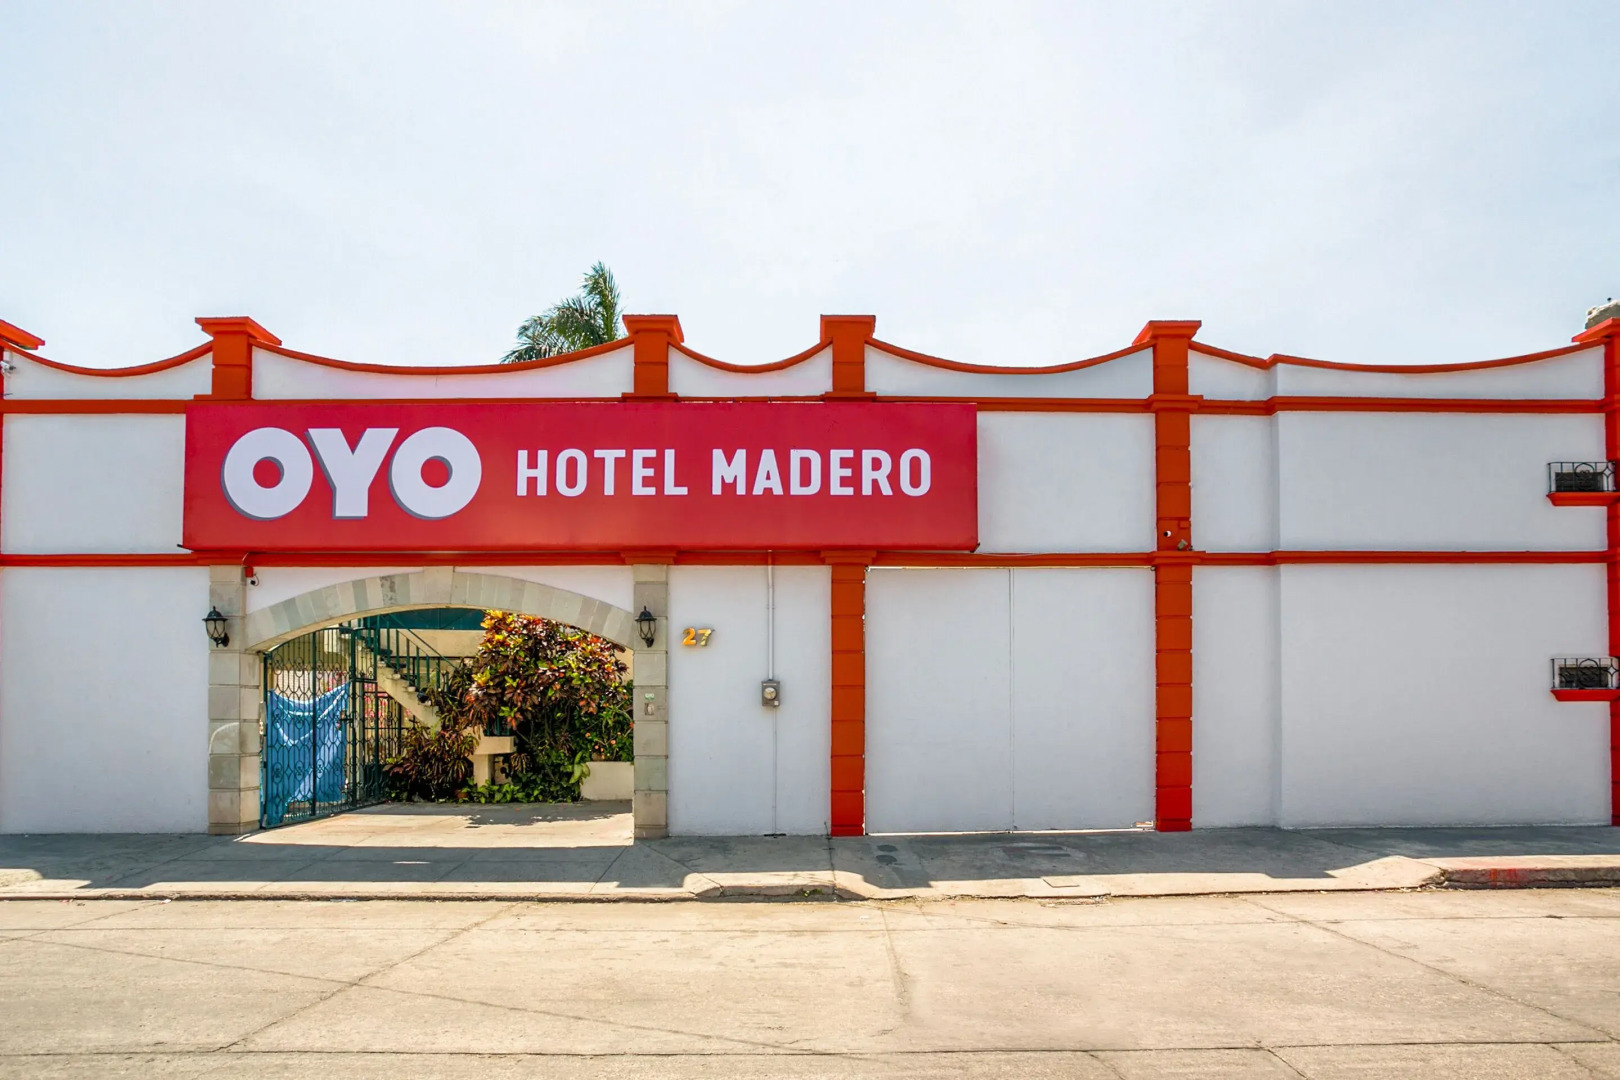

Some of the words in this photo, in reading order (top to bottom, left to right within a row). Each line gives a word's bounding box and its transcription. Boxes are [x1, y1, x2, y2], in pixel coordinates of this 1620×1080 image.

[223, 426, 482, 518] OYO
[516, 449, 688, 497] HOTEL
[711, 449, 932, 497] MADERO
[682, 627, 713, 647] 27
